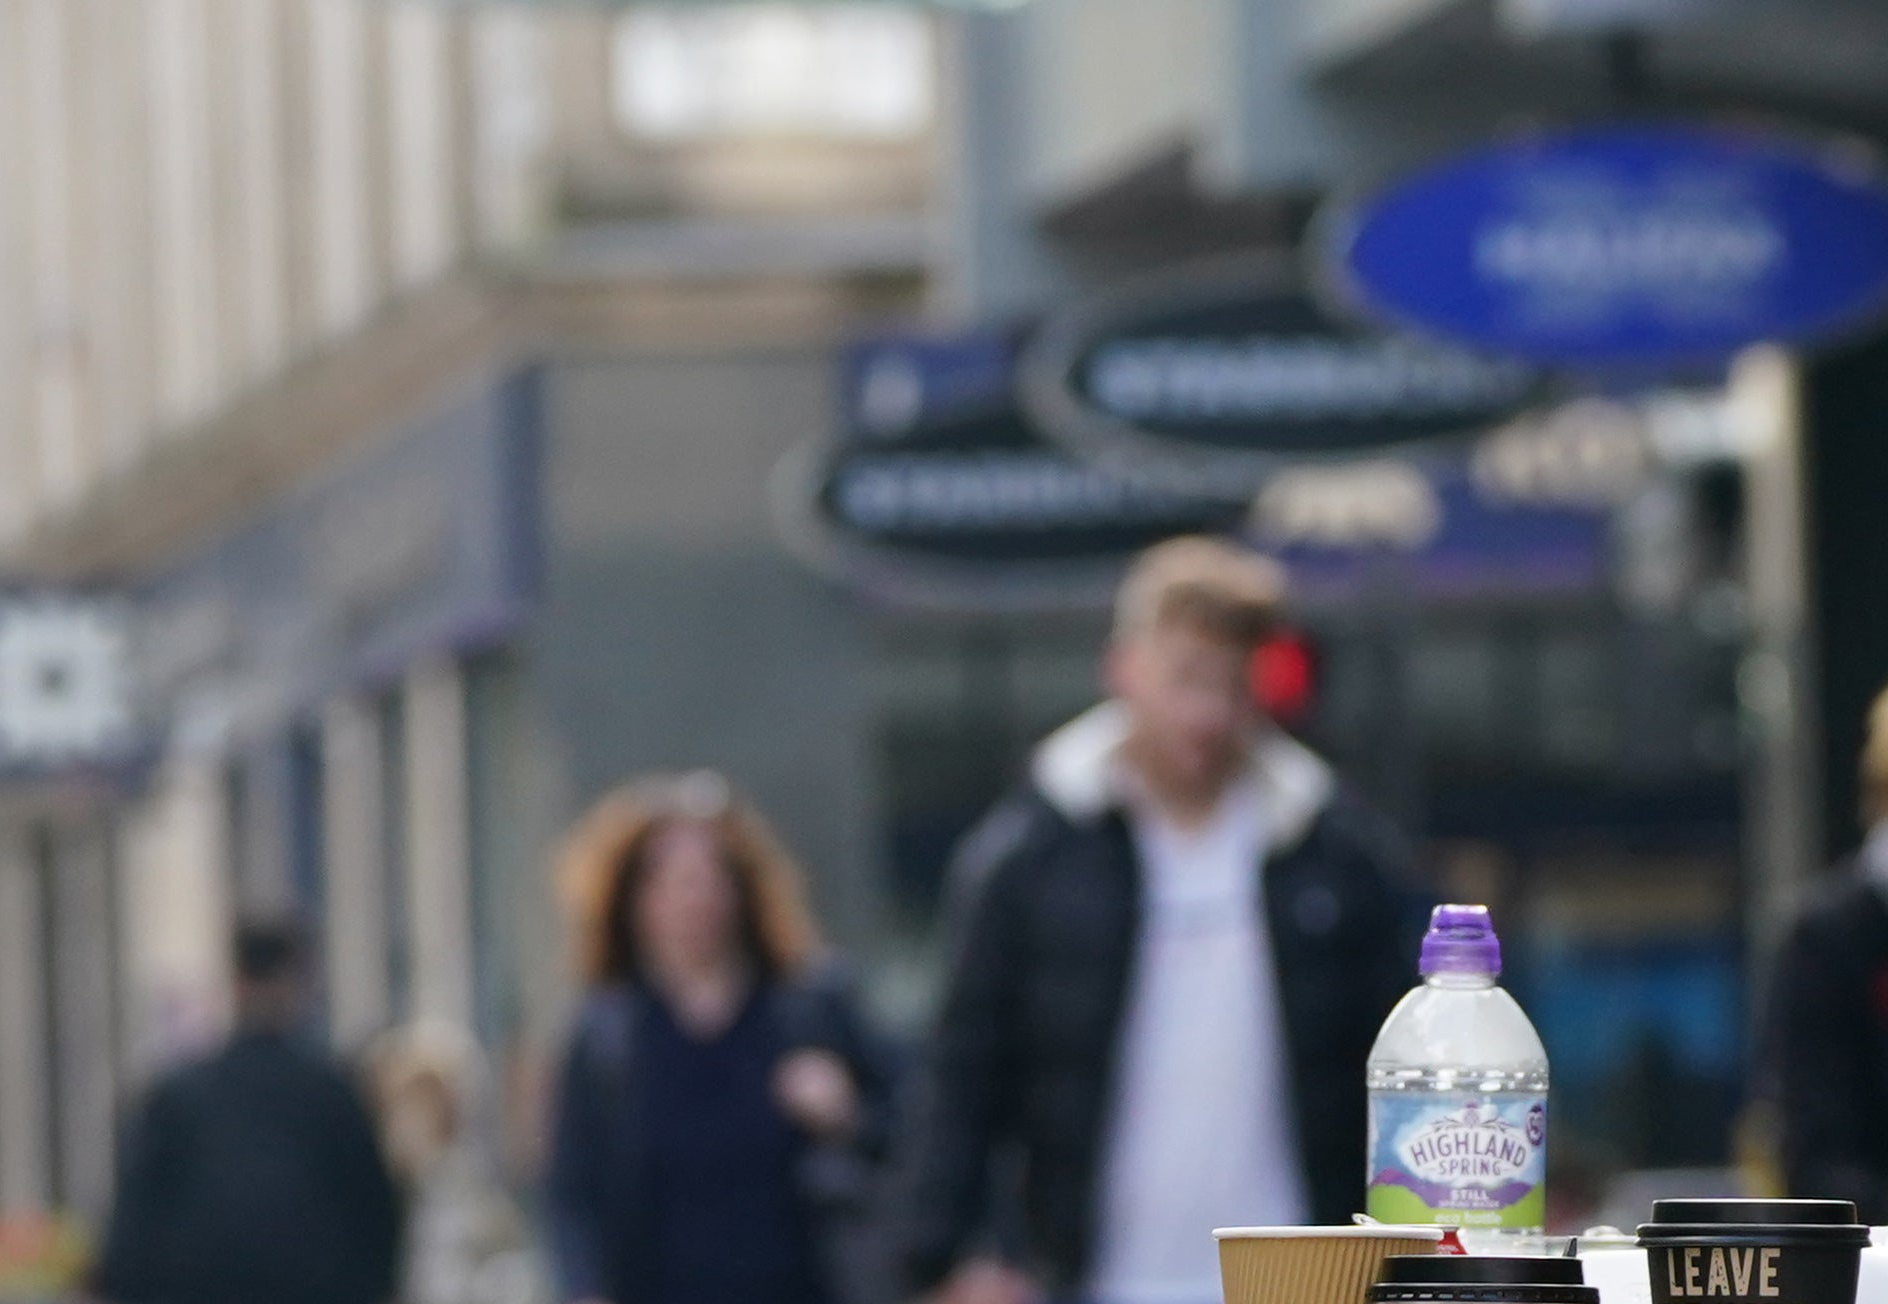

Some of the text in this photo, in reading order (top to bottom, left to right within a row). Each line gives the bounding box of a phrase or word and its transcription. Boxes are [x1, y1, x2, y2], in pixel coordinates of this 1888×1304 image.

[1410, 1132, 1526, 1167] HIGHLAND
[1439, 1158, 1502, 1176] SPRING
[1450, 1189, 1489, 1200] STILL
[1668, 1248, 1781, 1297] LEAVE
